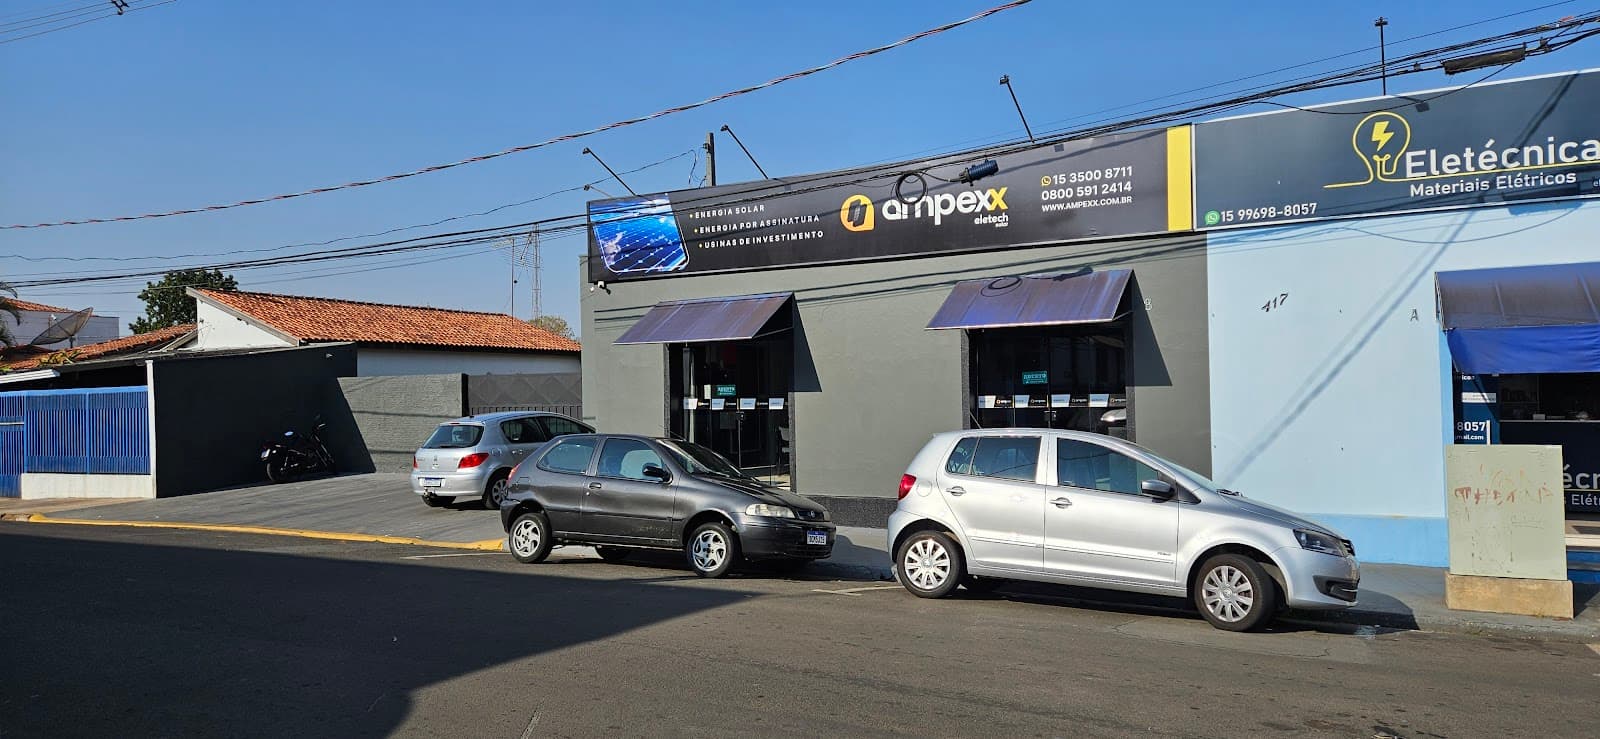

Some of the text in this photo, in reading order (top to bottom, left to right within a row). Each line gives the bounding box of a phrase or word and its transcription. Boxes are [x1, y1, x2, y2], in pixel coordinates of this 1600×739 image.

[1406, 136, 1600, 178] Eletécnica
[1052, 165, 1132, 184] 15 3500 8711
[1041, 181, 1132, 200] 0800 591 2414
[1410, 172, 1577, 197] Materiais Elétricos
[695, 204, 765, 219] ENERGIA SOLAR
[881, 187, 1009, 226] ampexx
[1041, 196, 1132, 212] WWW.AMPEXX.COM.BR
[1220, 202, 1317, 222] 15 99698-8057
[699, 214, 820, 234] ENERGIA POR ASSINATURA
[974, 212, 1009, 225] eletech
[704, 230, 824, 249] USINAS DE INVESTIMENTO
[1260, 292, 1289, 313] 417
[1409, 308, 1420, 322] A
